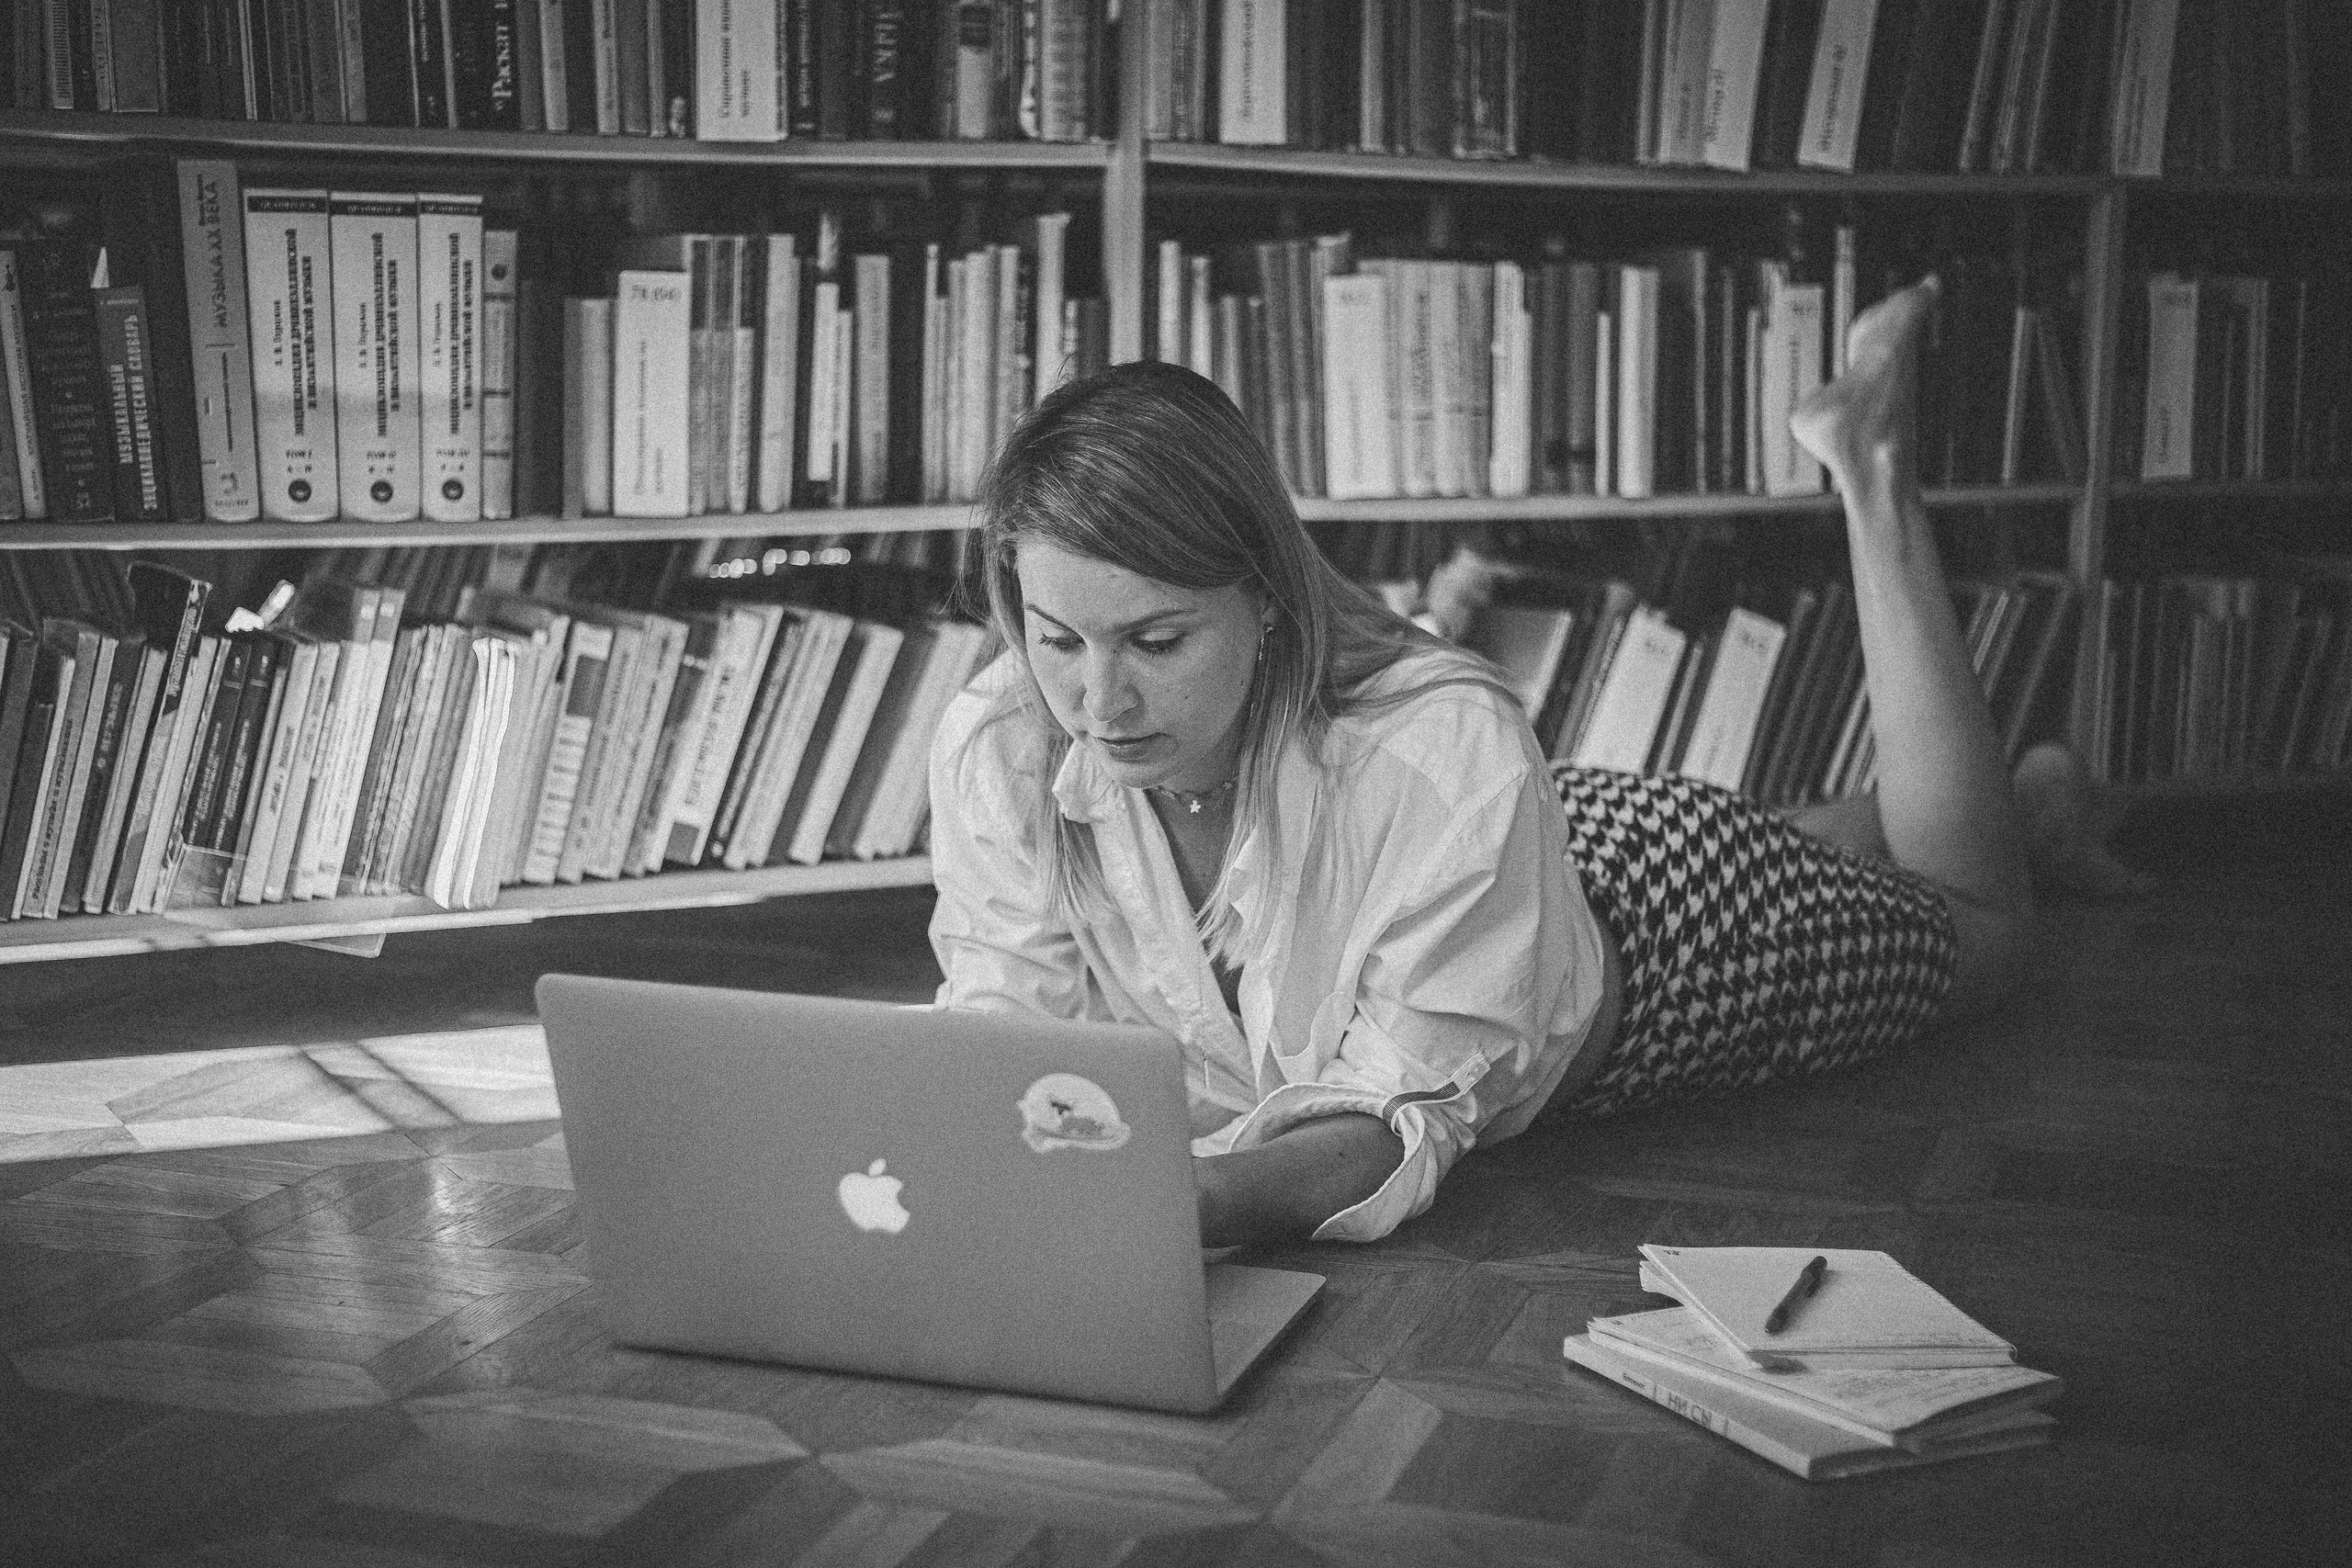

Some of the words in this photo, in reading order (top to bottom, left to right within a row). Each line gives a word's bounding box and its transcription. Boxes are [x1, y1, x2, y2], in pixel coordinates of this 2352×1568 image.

[204, 180, 220, 224] ВЕКА
[207, 227, 221, 251] XX
[209, 254, 227, 328] МУЗЫКА
[10, 303, 22, 344] МУЗЫКИ
[124, 315, 142, 370] СЛОВАРЬ
[15, 345, 28, 390] ИСТОРИЯ
[109, 364, 133, 464] МУЗЫКАЛЬНЫЙ
[129, 376, 157, 510] ЭНЦИКЛОПЕДИЧЕСКИЙ
[1668, 1392, 1689, 1412] НИ
[1691, 1404, 1712, 1427] СЫ
